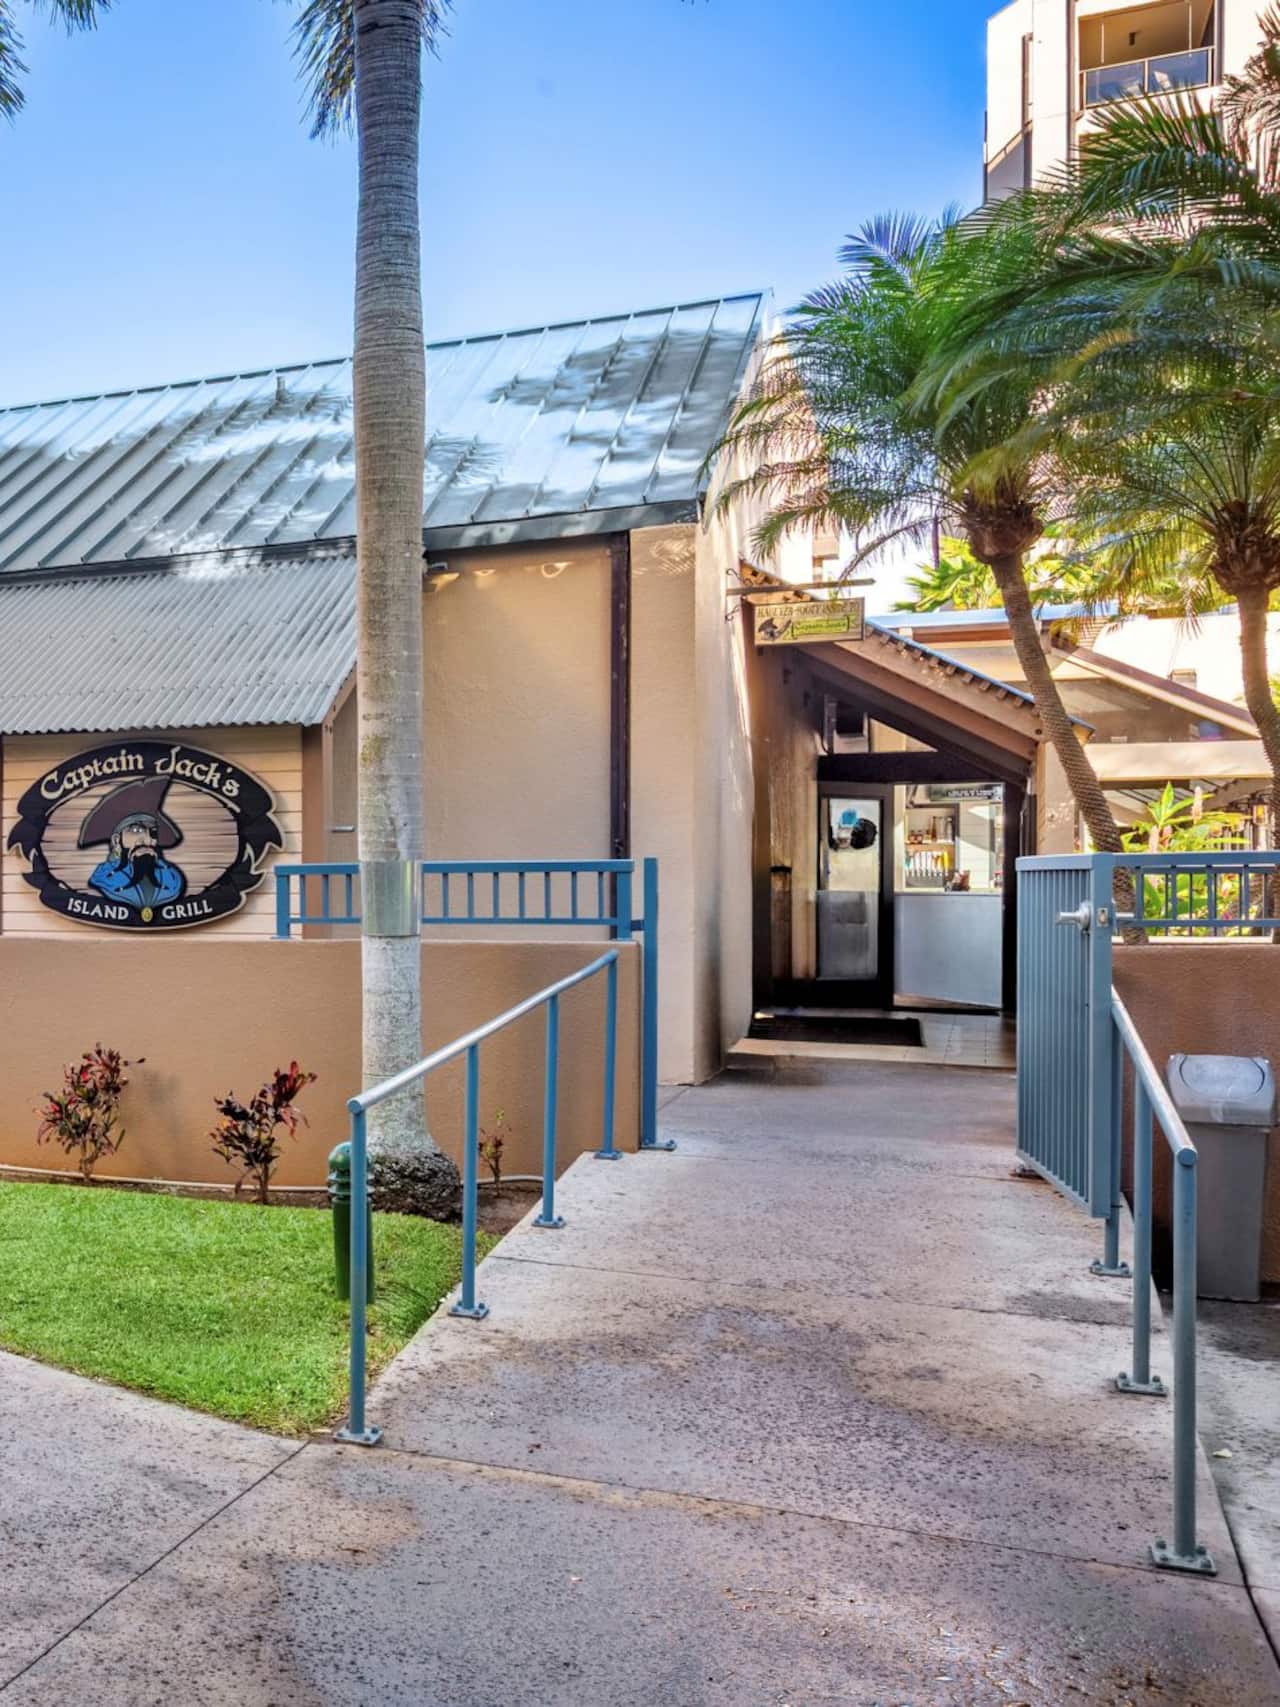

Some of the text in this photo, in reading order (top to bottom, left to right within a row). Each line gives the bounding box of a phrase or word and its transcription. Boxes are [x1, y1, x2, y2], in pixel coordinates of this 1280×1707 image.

[40, 745, 241, 800] Captain Jack's
[67, 897, 213, 920] ISLAND GRILL
